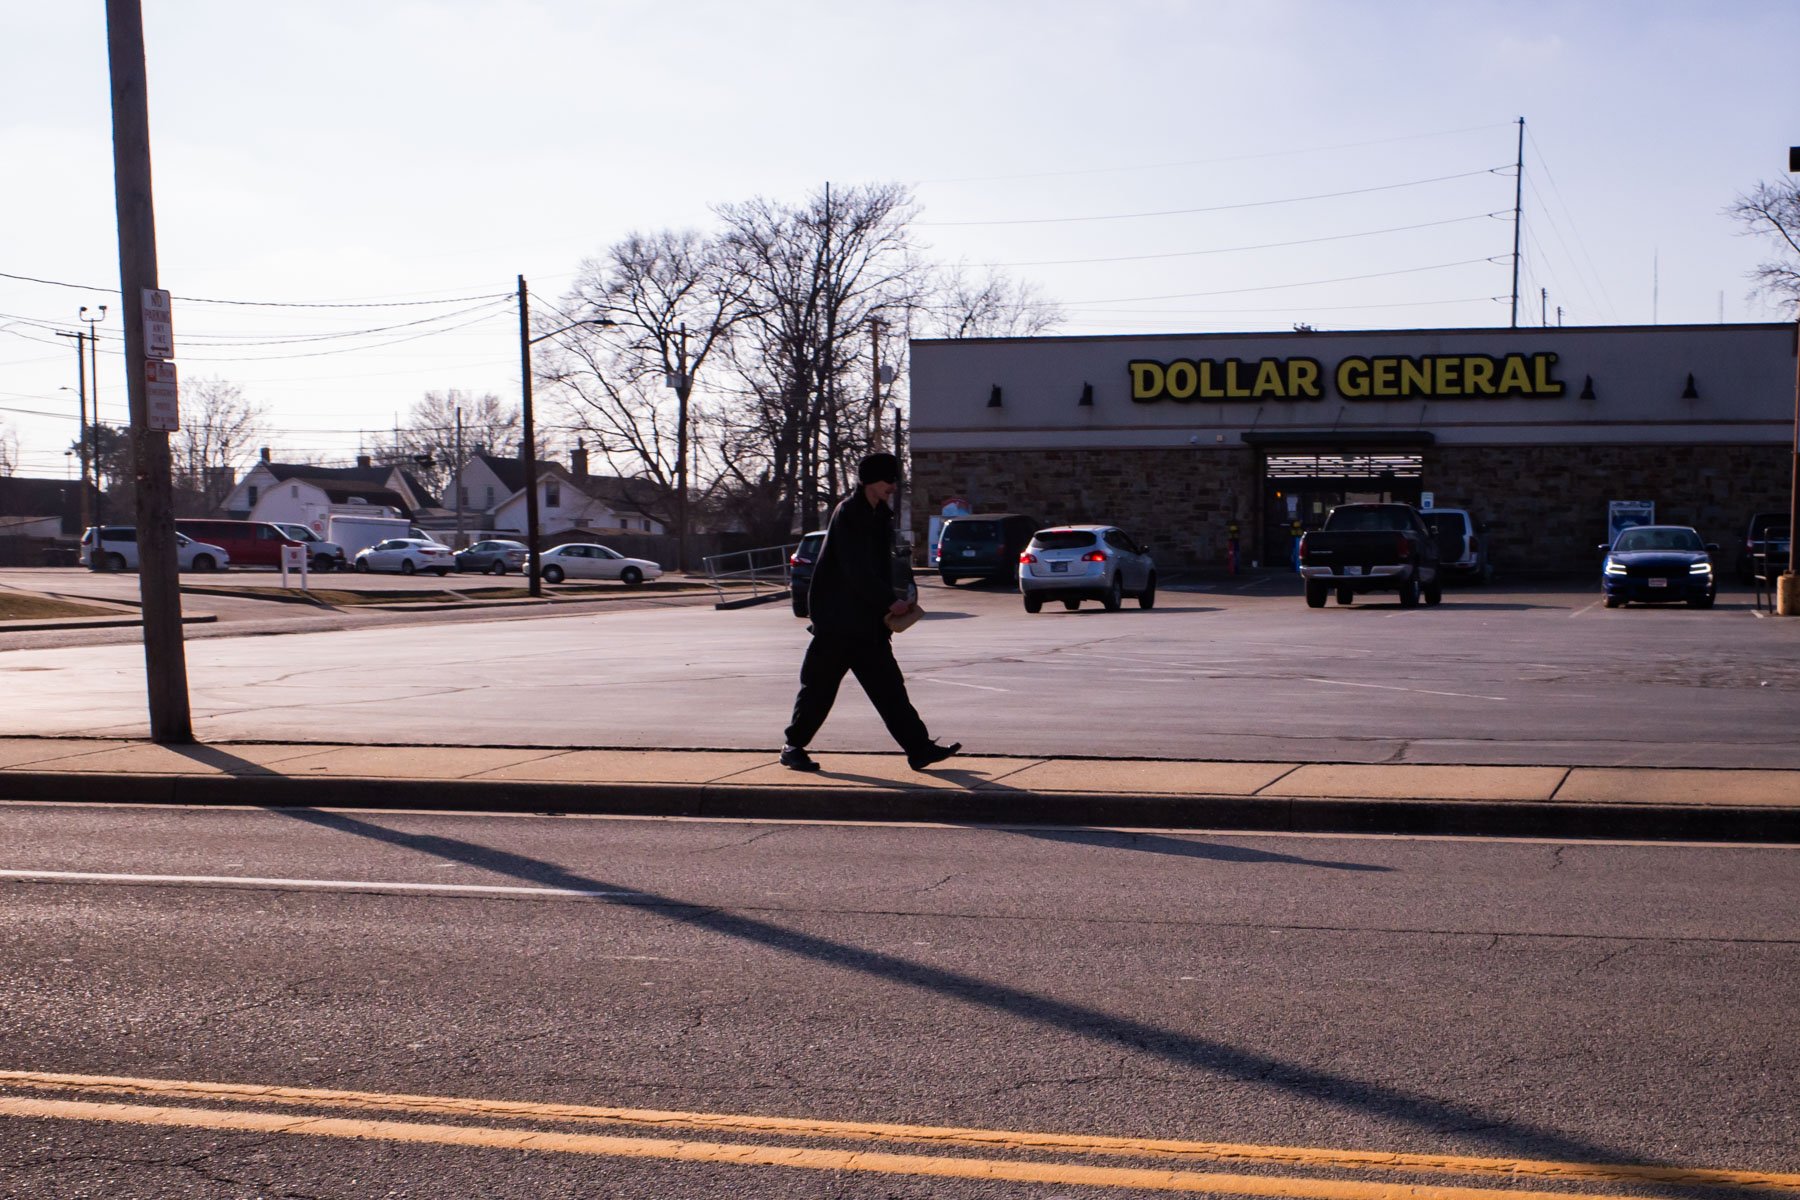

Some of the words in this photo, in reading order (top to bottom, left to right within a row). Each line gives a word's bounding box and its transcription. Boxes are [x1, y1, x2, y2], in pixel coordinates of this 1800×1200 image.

[151, 294, 163, 308] NO
[144, 309, 170, 323] PARKING
[1130, 360, 1320, 398] DOLLAR
[1337, 356, 1561, 397] GENERAL
